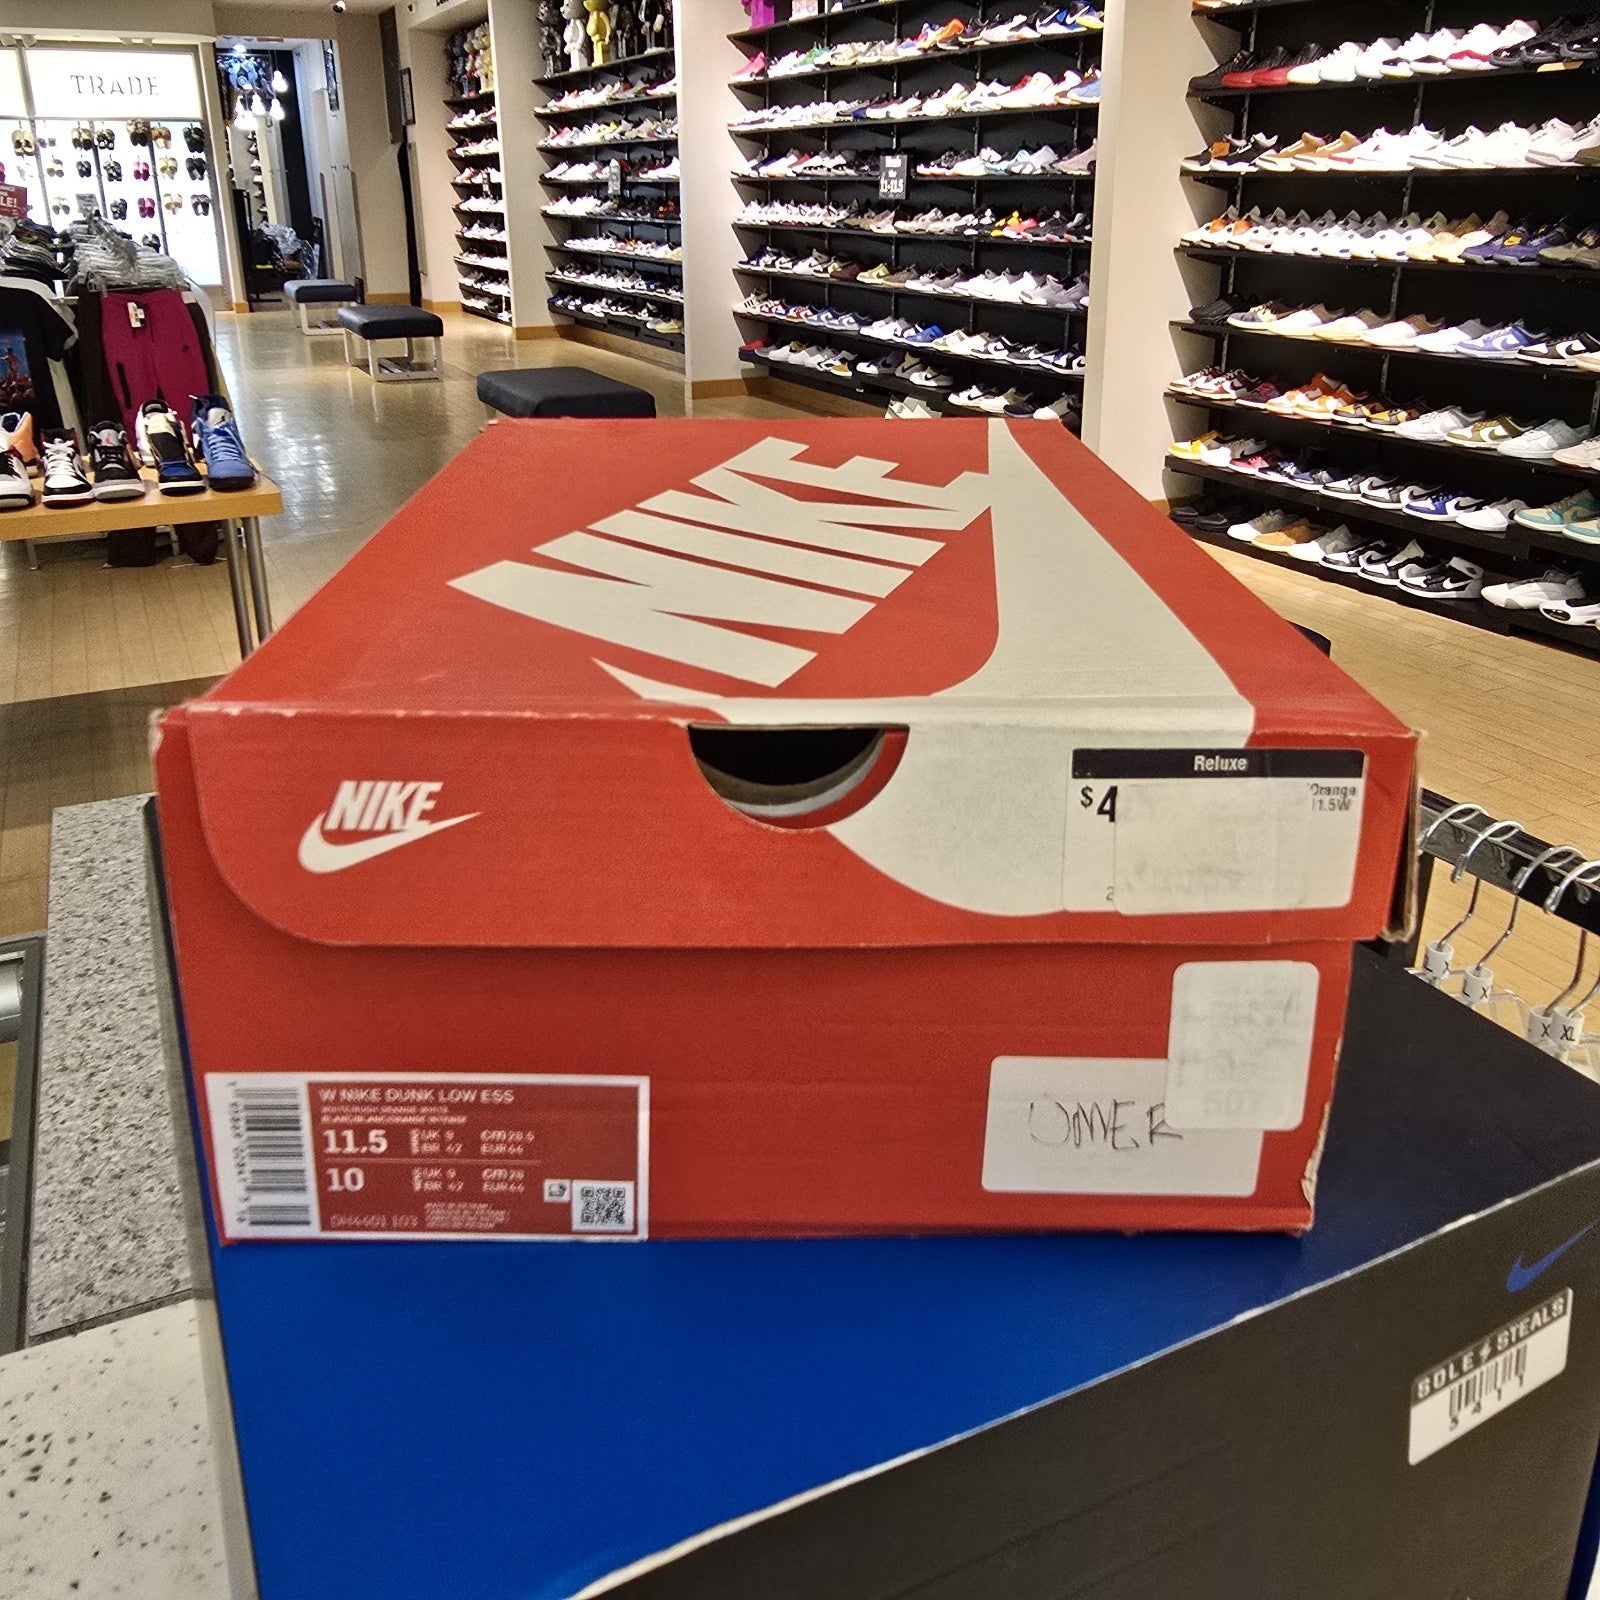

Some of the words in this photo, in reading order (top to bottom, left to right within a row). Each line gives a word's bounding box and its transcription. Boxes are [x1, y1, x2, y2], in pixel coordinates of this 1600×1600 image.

[70, 74, 160, 96] TRADE
[445, 436, 990, 688] NIKE
[1193, 754, 1249, 772] Reluxe
[323, 780, 444, 832] NIKE
[340, 1088, 381, 1102] NIKE
[385, 1088, 434, 1103] DUNK
[438, 1089, 477, 1104] LOW
[479, 1090, 515, 1104] ESS
[322, 1129, 388, 1154] 11.5
[325, 1167, 365, 1192] 10
[1417, 1350, 1474, 1400] SOLE
[1497, 1297, 1565, 1352] STEALS
